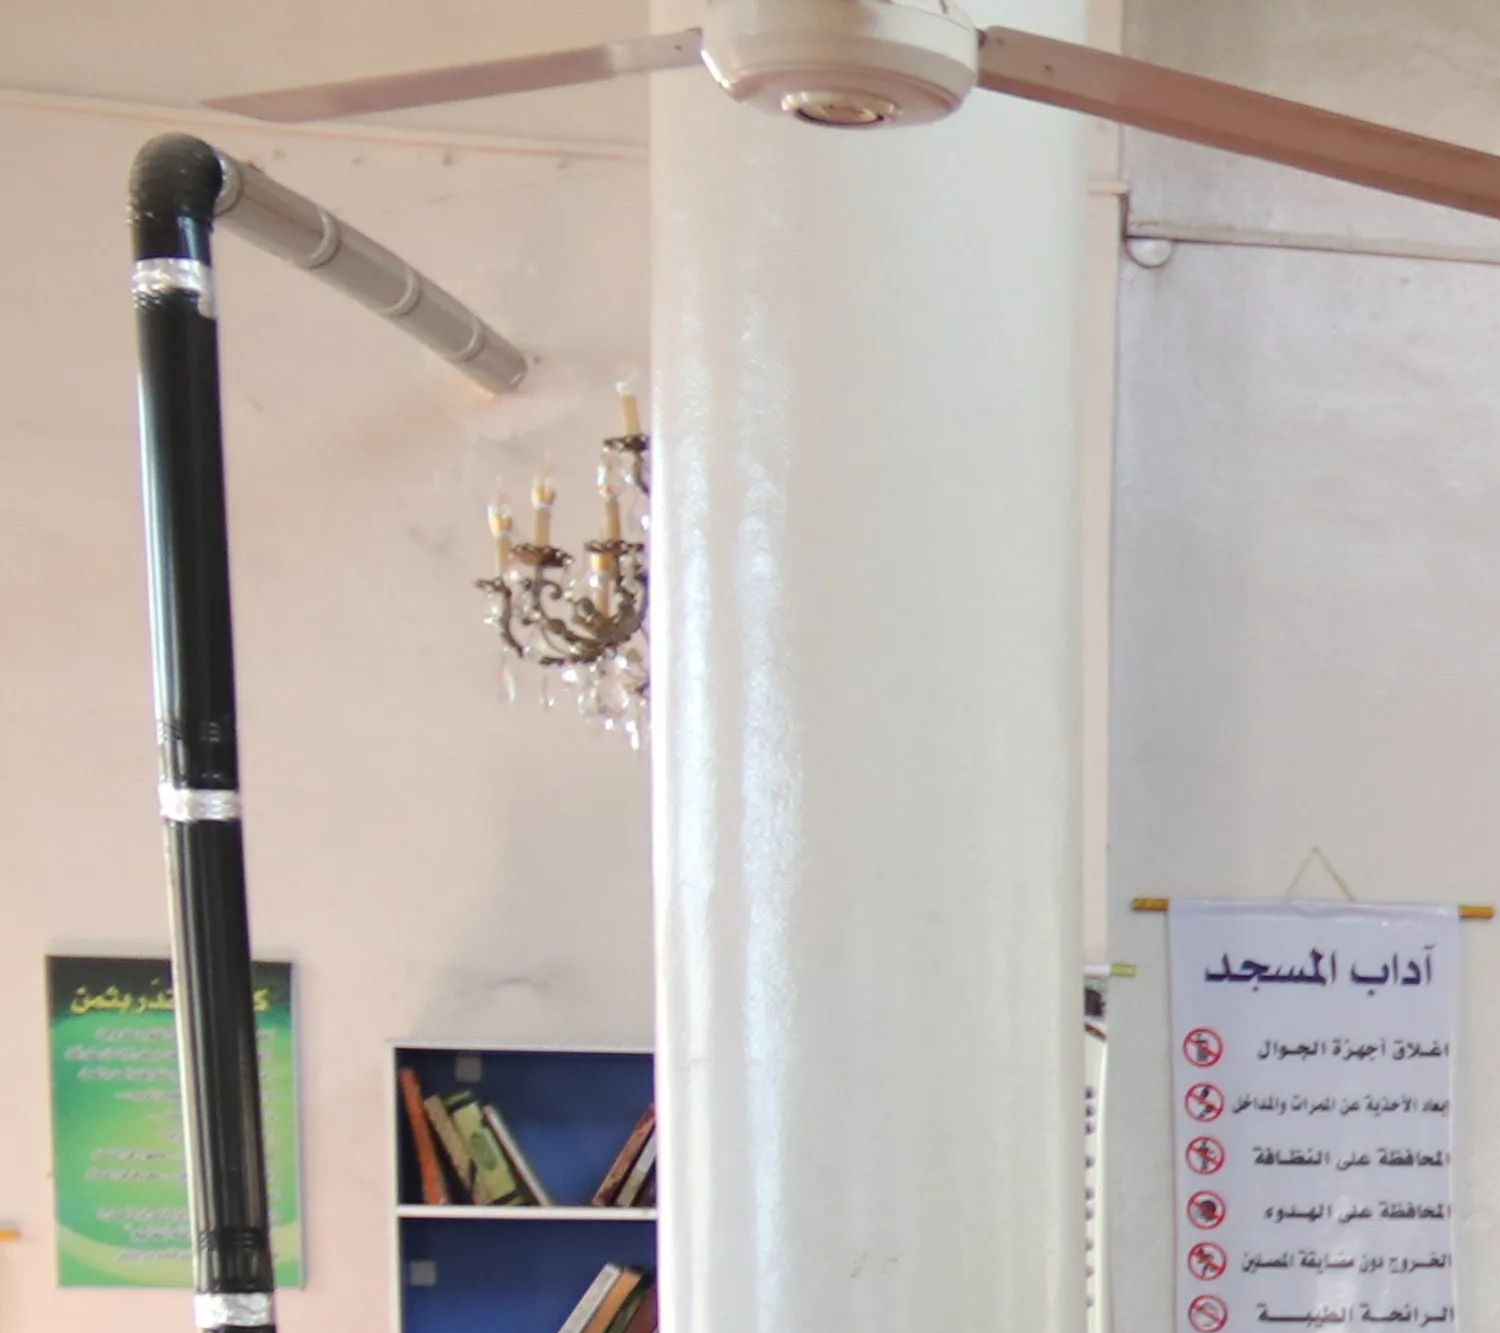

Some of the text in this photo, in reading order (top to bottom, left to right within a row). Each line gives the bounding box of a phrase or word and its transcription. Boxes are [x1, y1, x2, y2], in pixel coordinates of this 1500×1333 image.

[1204, 942, 1437, 997] آداب المسجد
[1257, 1038, 1327, 1061] الجوال
[1340, 1097, 1361, 1117] عن
[1252, 1146, 1451, 1171] المحافظة على النظافة
[1263, 1201, 1451, 1224] المحافظة على الهدوء
[1241, 1252, 1295, 1274] المصلين
[1358, 1251, 1384, 1274] دون
[1387, 1249, 1452, 1274] الخروج
